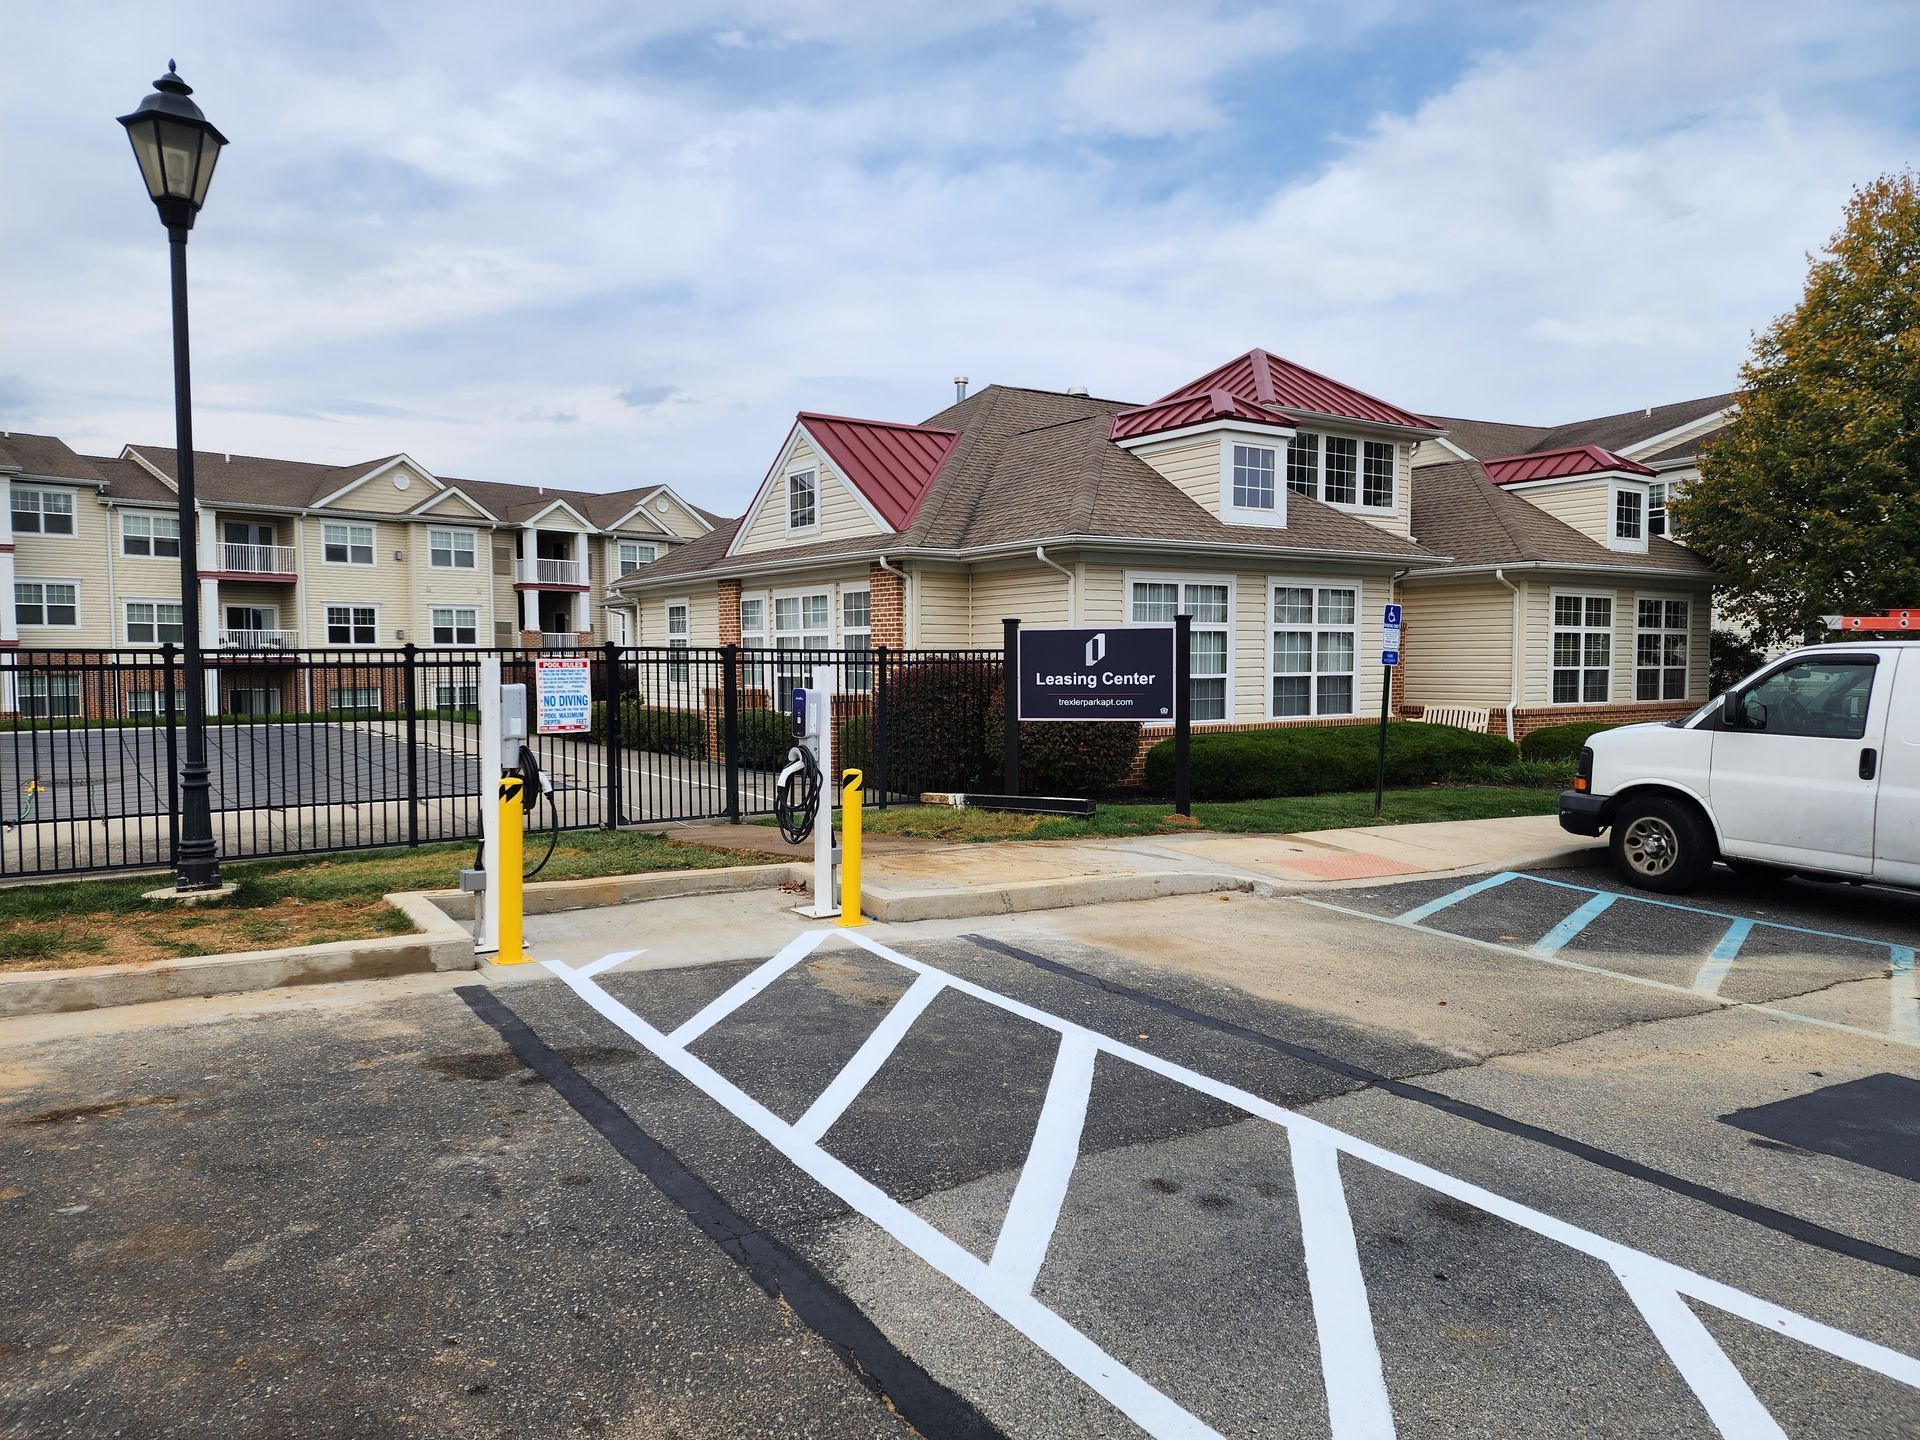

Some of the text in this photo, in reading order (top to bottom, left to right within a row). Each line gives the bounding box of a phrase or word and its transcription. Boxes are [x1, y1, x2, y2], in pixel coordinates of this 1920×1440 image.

[1036, 671, 1156, 688] Leasing Center
[544, 694, 588, 707] NO DIVING
[1058, 698, 1134, 707] trexlerparkapt.com
